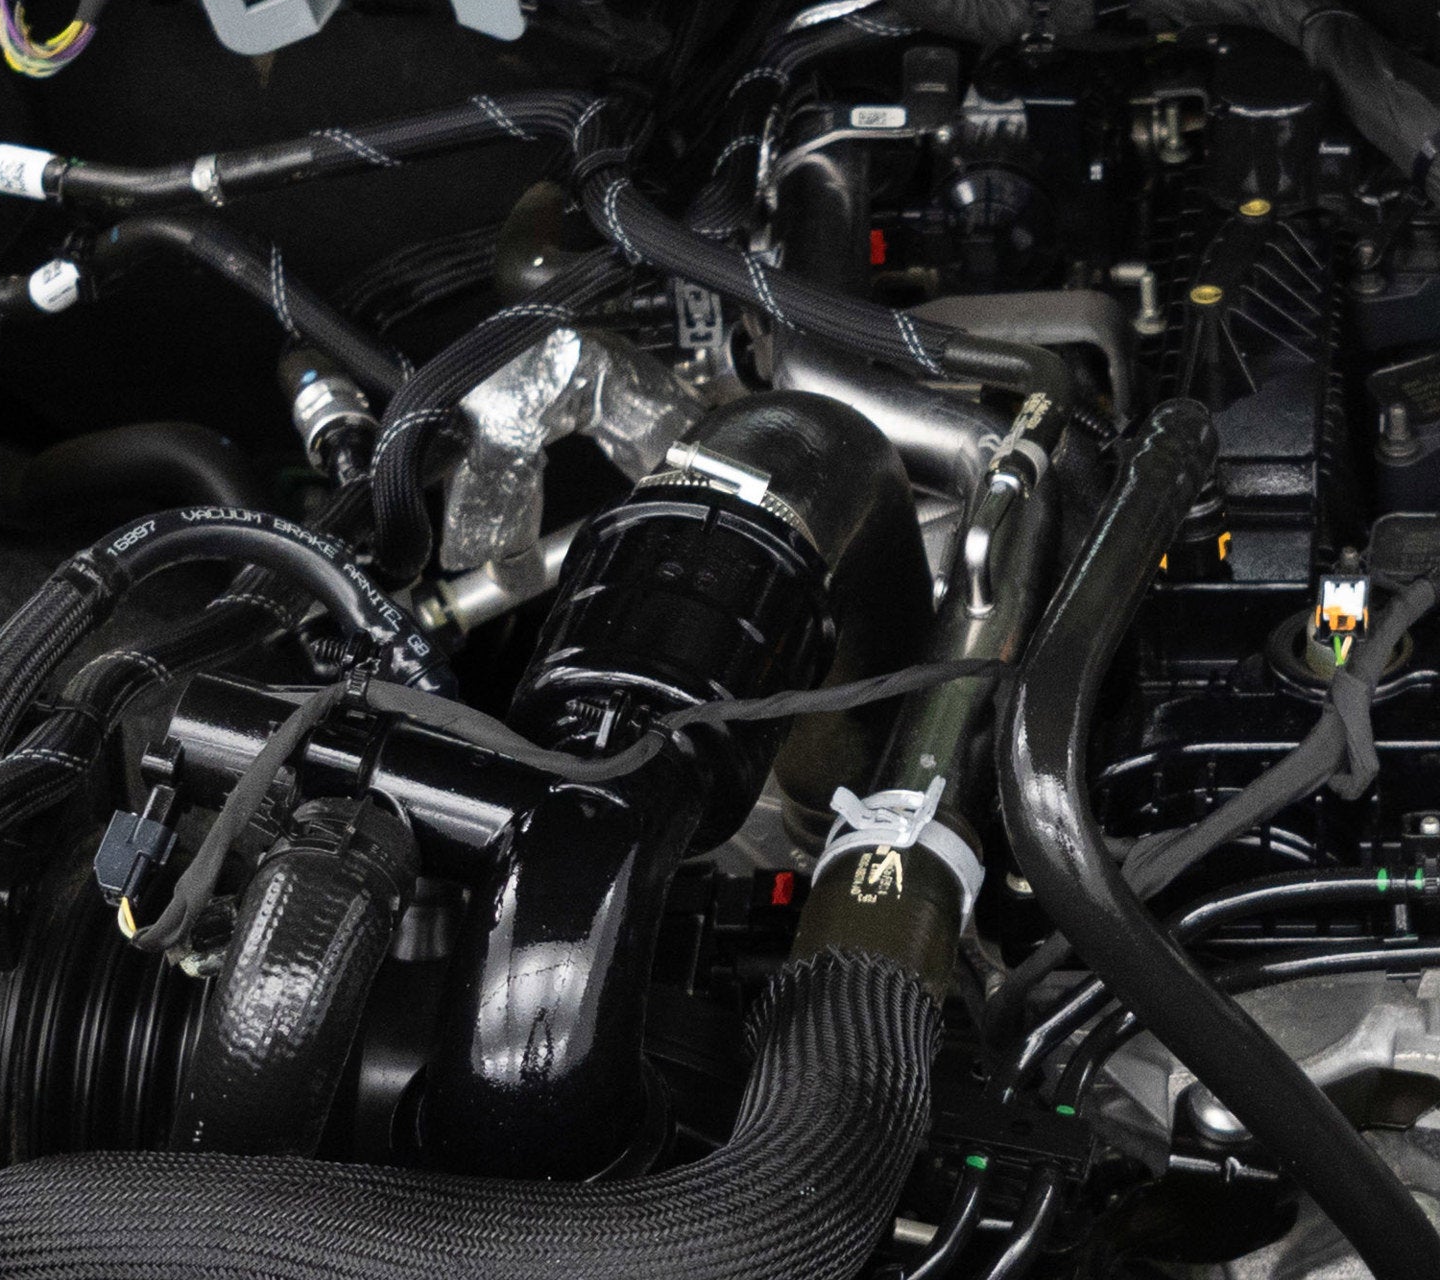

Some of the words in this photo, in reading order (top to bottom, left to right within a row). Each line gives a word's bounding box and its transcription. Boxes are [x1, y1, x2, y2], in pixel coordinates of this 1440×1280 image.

[107, 520, 158, 557] 16897
[181, 507, 262, 524] VACUUM
[272, 518, 336, 559] BRAKE
[343, 563, 403, 632] ARNITEL
[406, 634, 431, 658] GB
